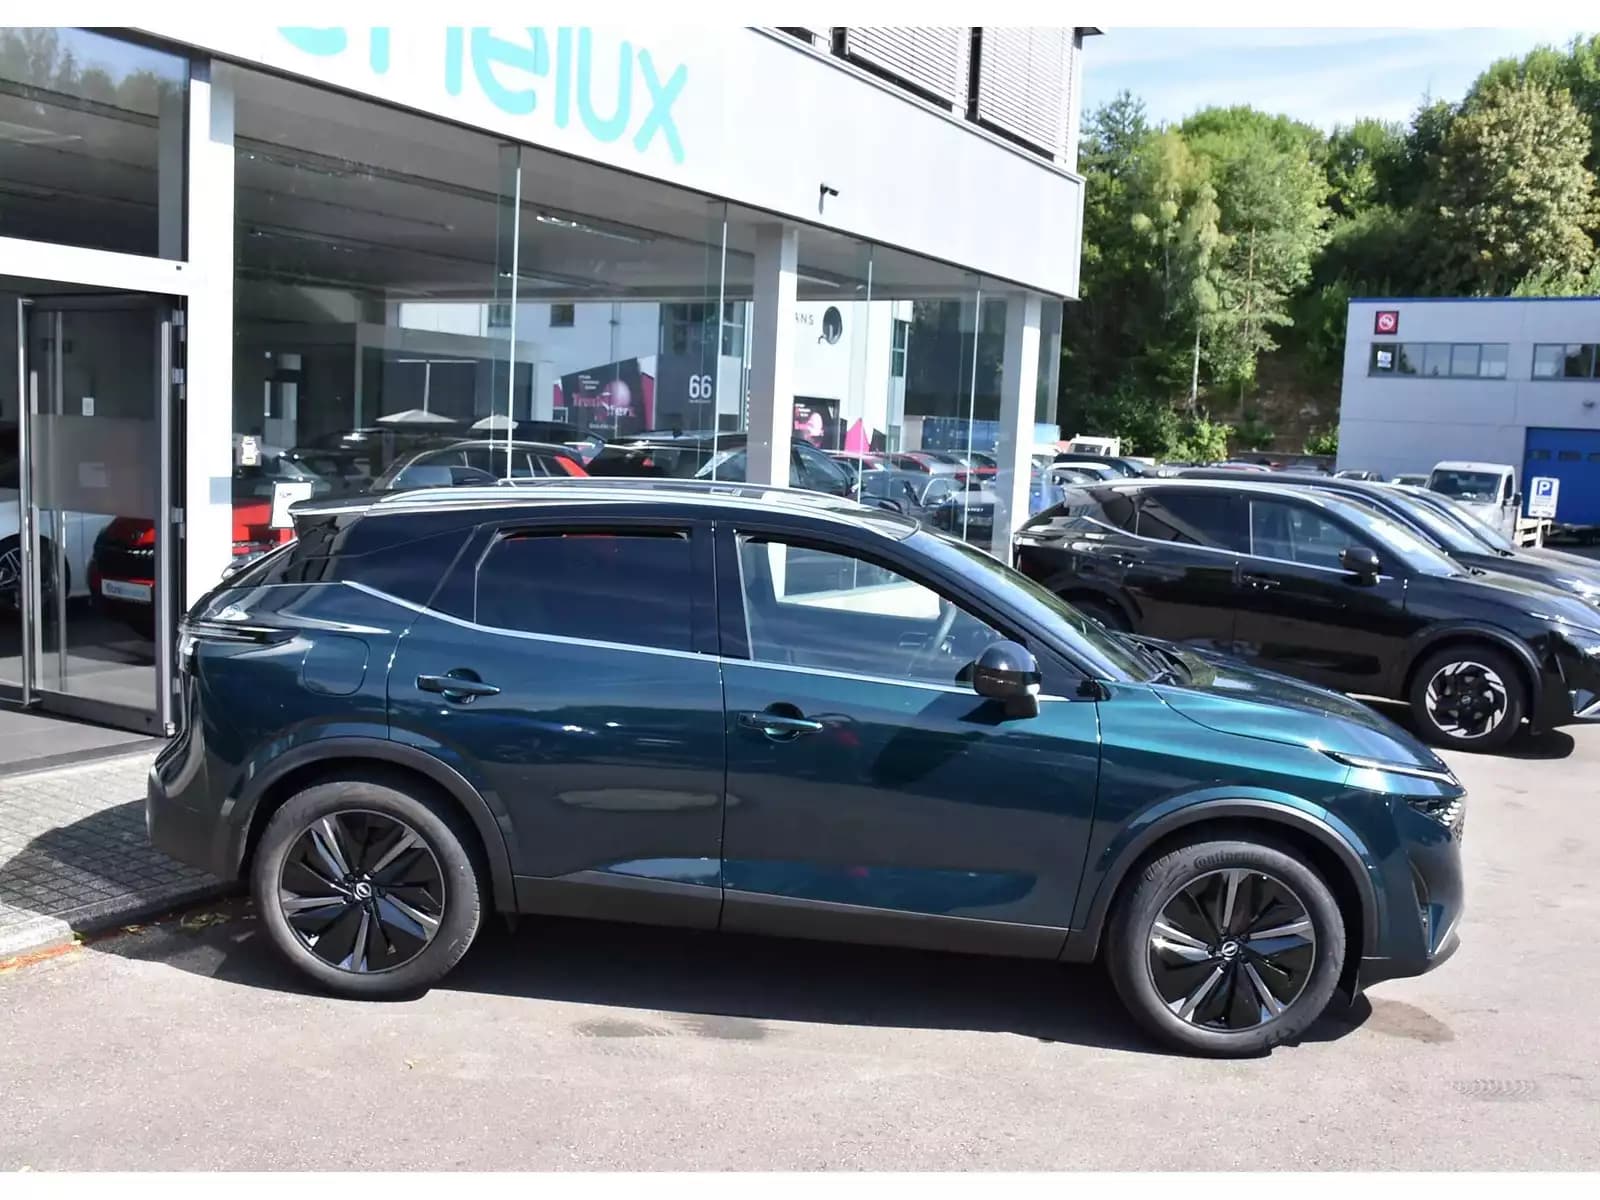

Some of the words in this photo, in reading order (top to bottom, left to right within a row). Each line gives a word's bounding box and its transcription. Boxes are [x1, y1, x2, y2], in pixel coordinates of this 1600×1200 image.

[276, 27, 689, 165] elux
[689, 374, 712, 398] 66
[1539, 481, 1551, 496] P
